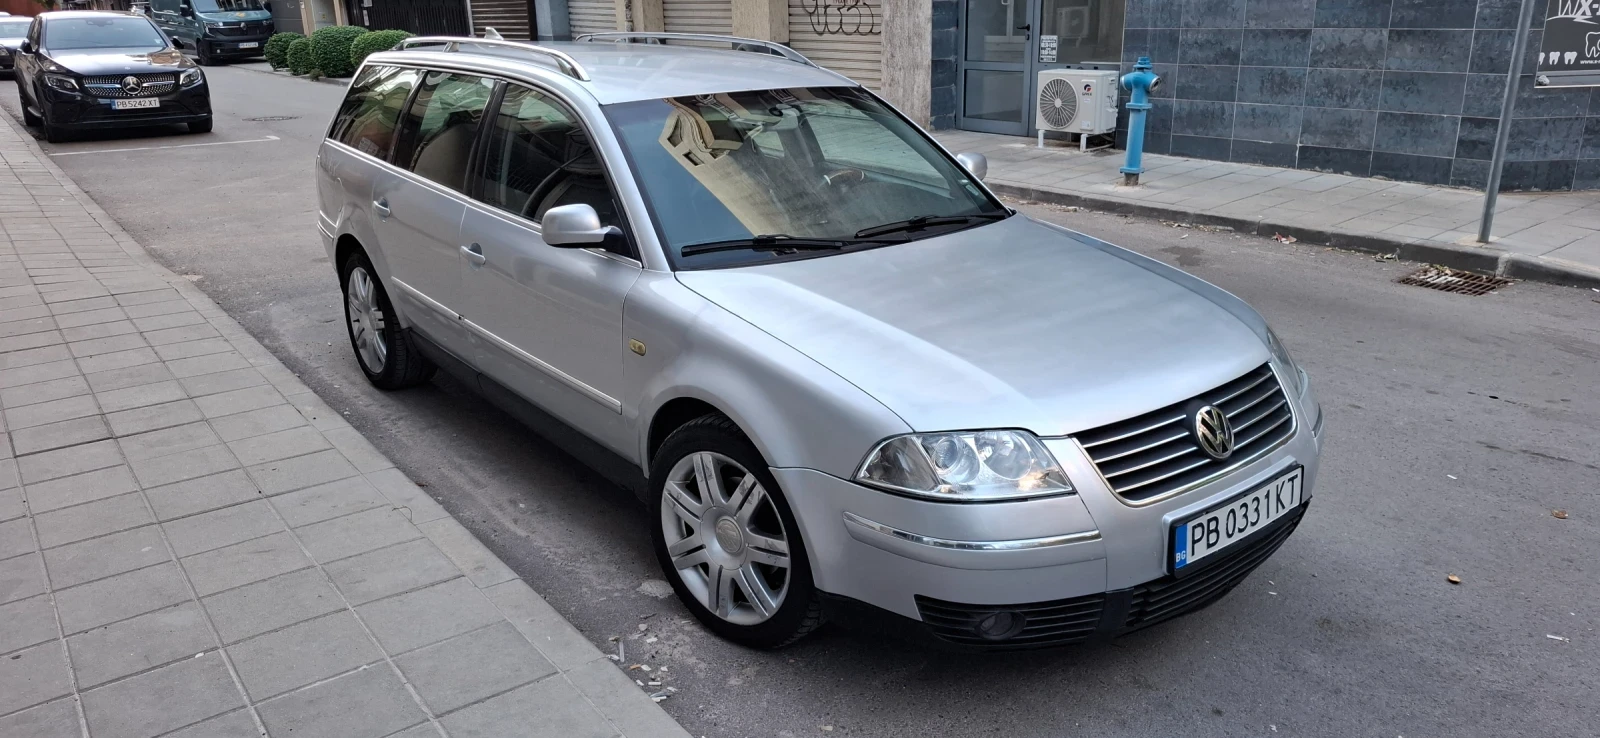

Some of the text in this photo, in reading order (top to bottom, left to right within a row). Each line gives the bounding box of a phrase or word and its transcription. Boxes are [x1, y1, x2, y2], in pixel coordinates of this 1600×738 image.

[1192, 472, 1298, 557] PB 0331 KT
[1176, 550, 1186, 563] BG
